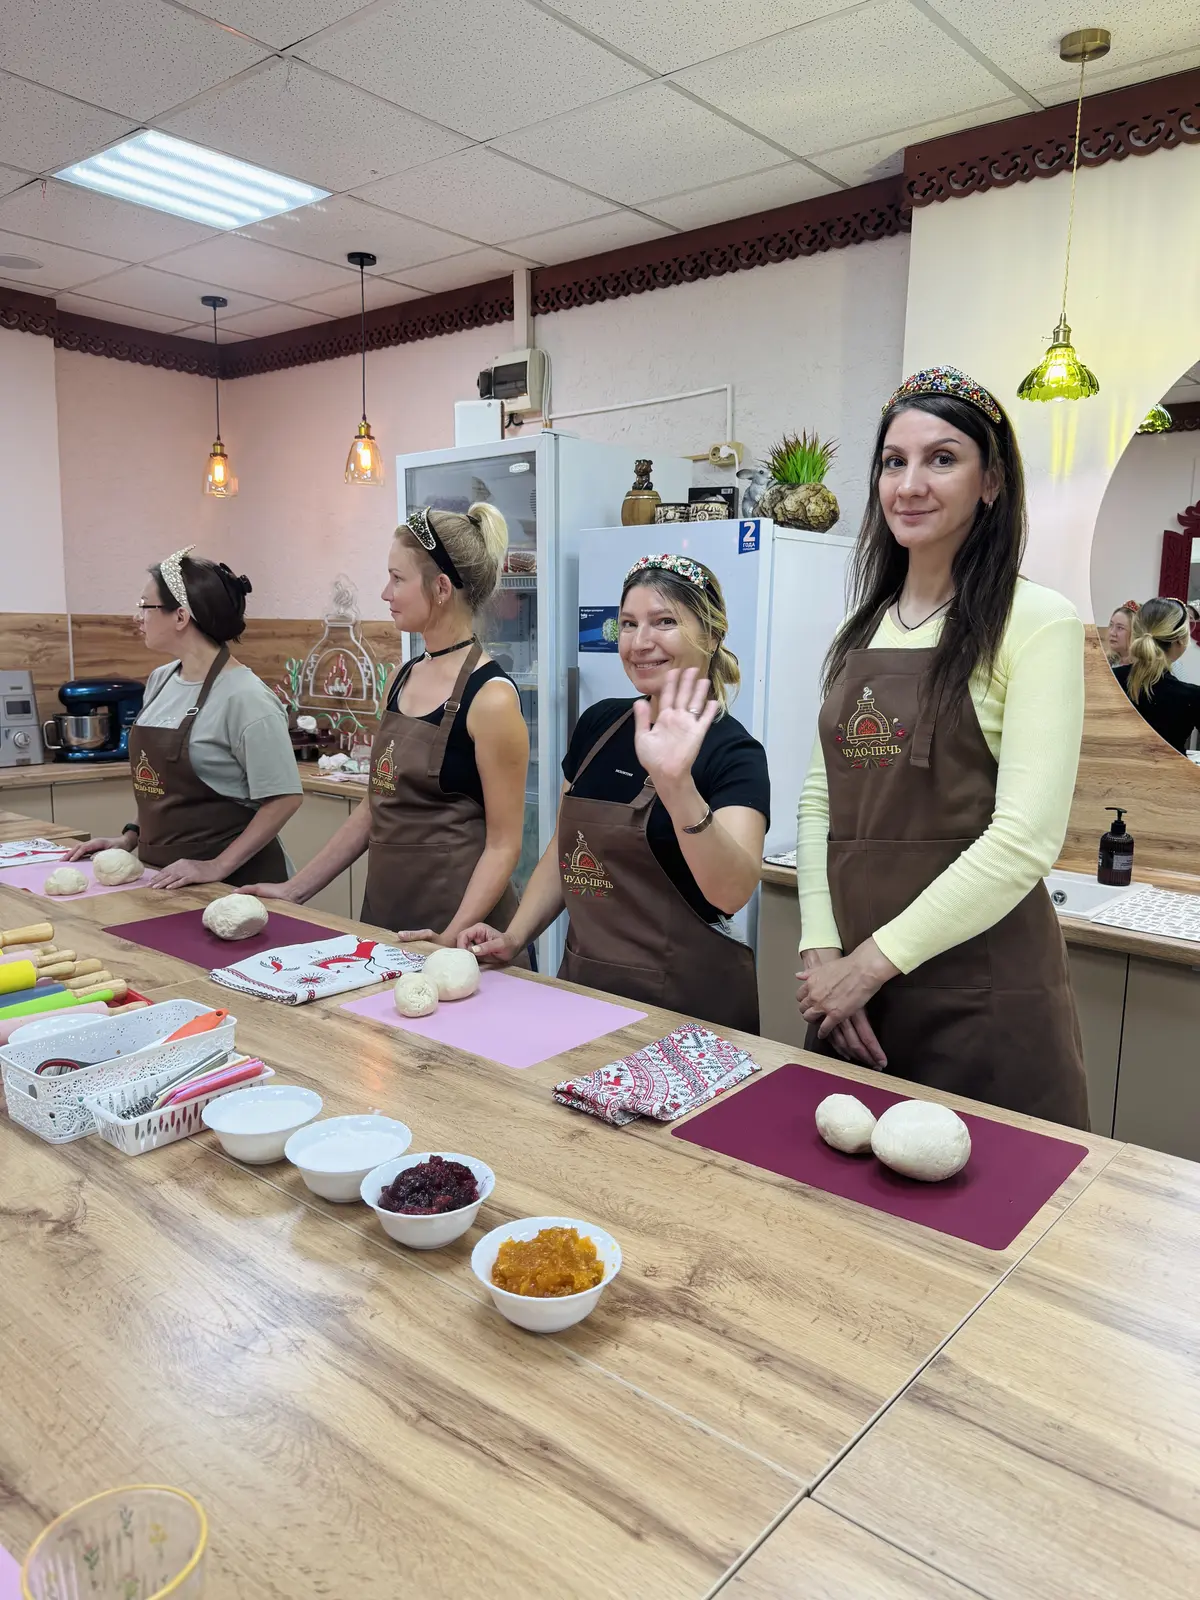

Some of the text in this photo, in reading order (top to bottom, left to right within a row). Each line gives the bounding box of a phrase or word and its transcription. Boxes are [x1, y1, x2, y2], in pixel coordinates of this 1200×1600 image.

[743, 521, 756, 542] 2
[842, 745, 902, 758] ЧУДО-ПЕЧЬ
[563, 874, 614, 889] ЧУДО-ПЕЧЬ
